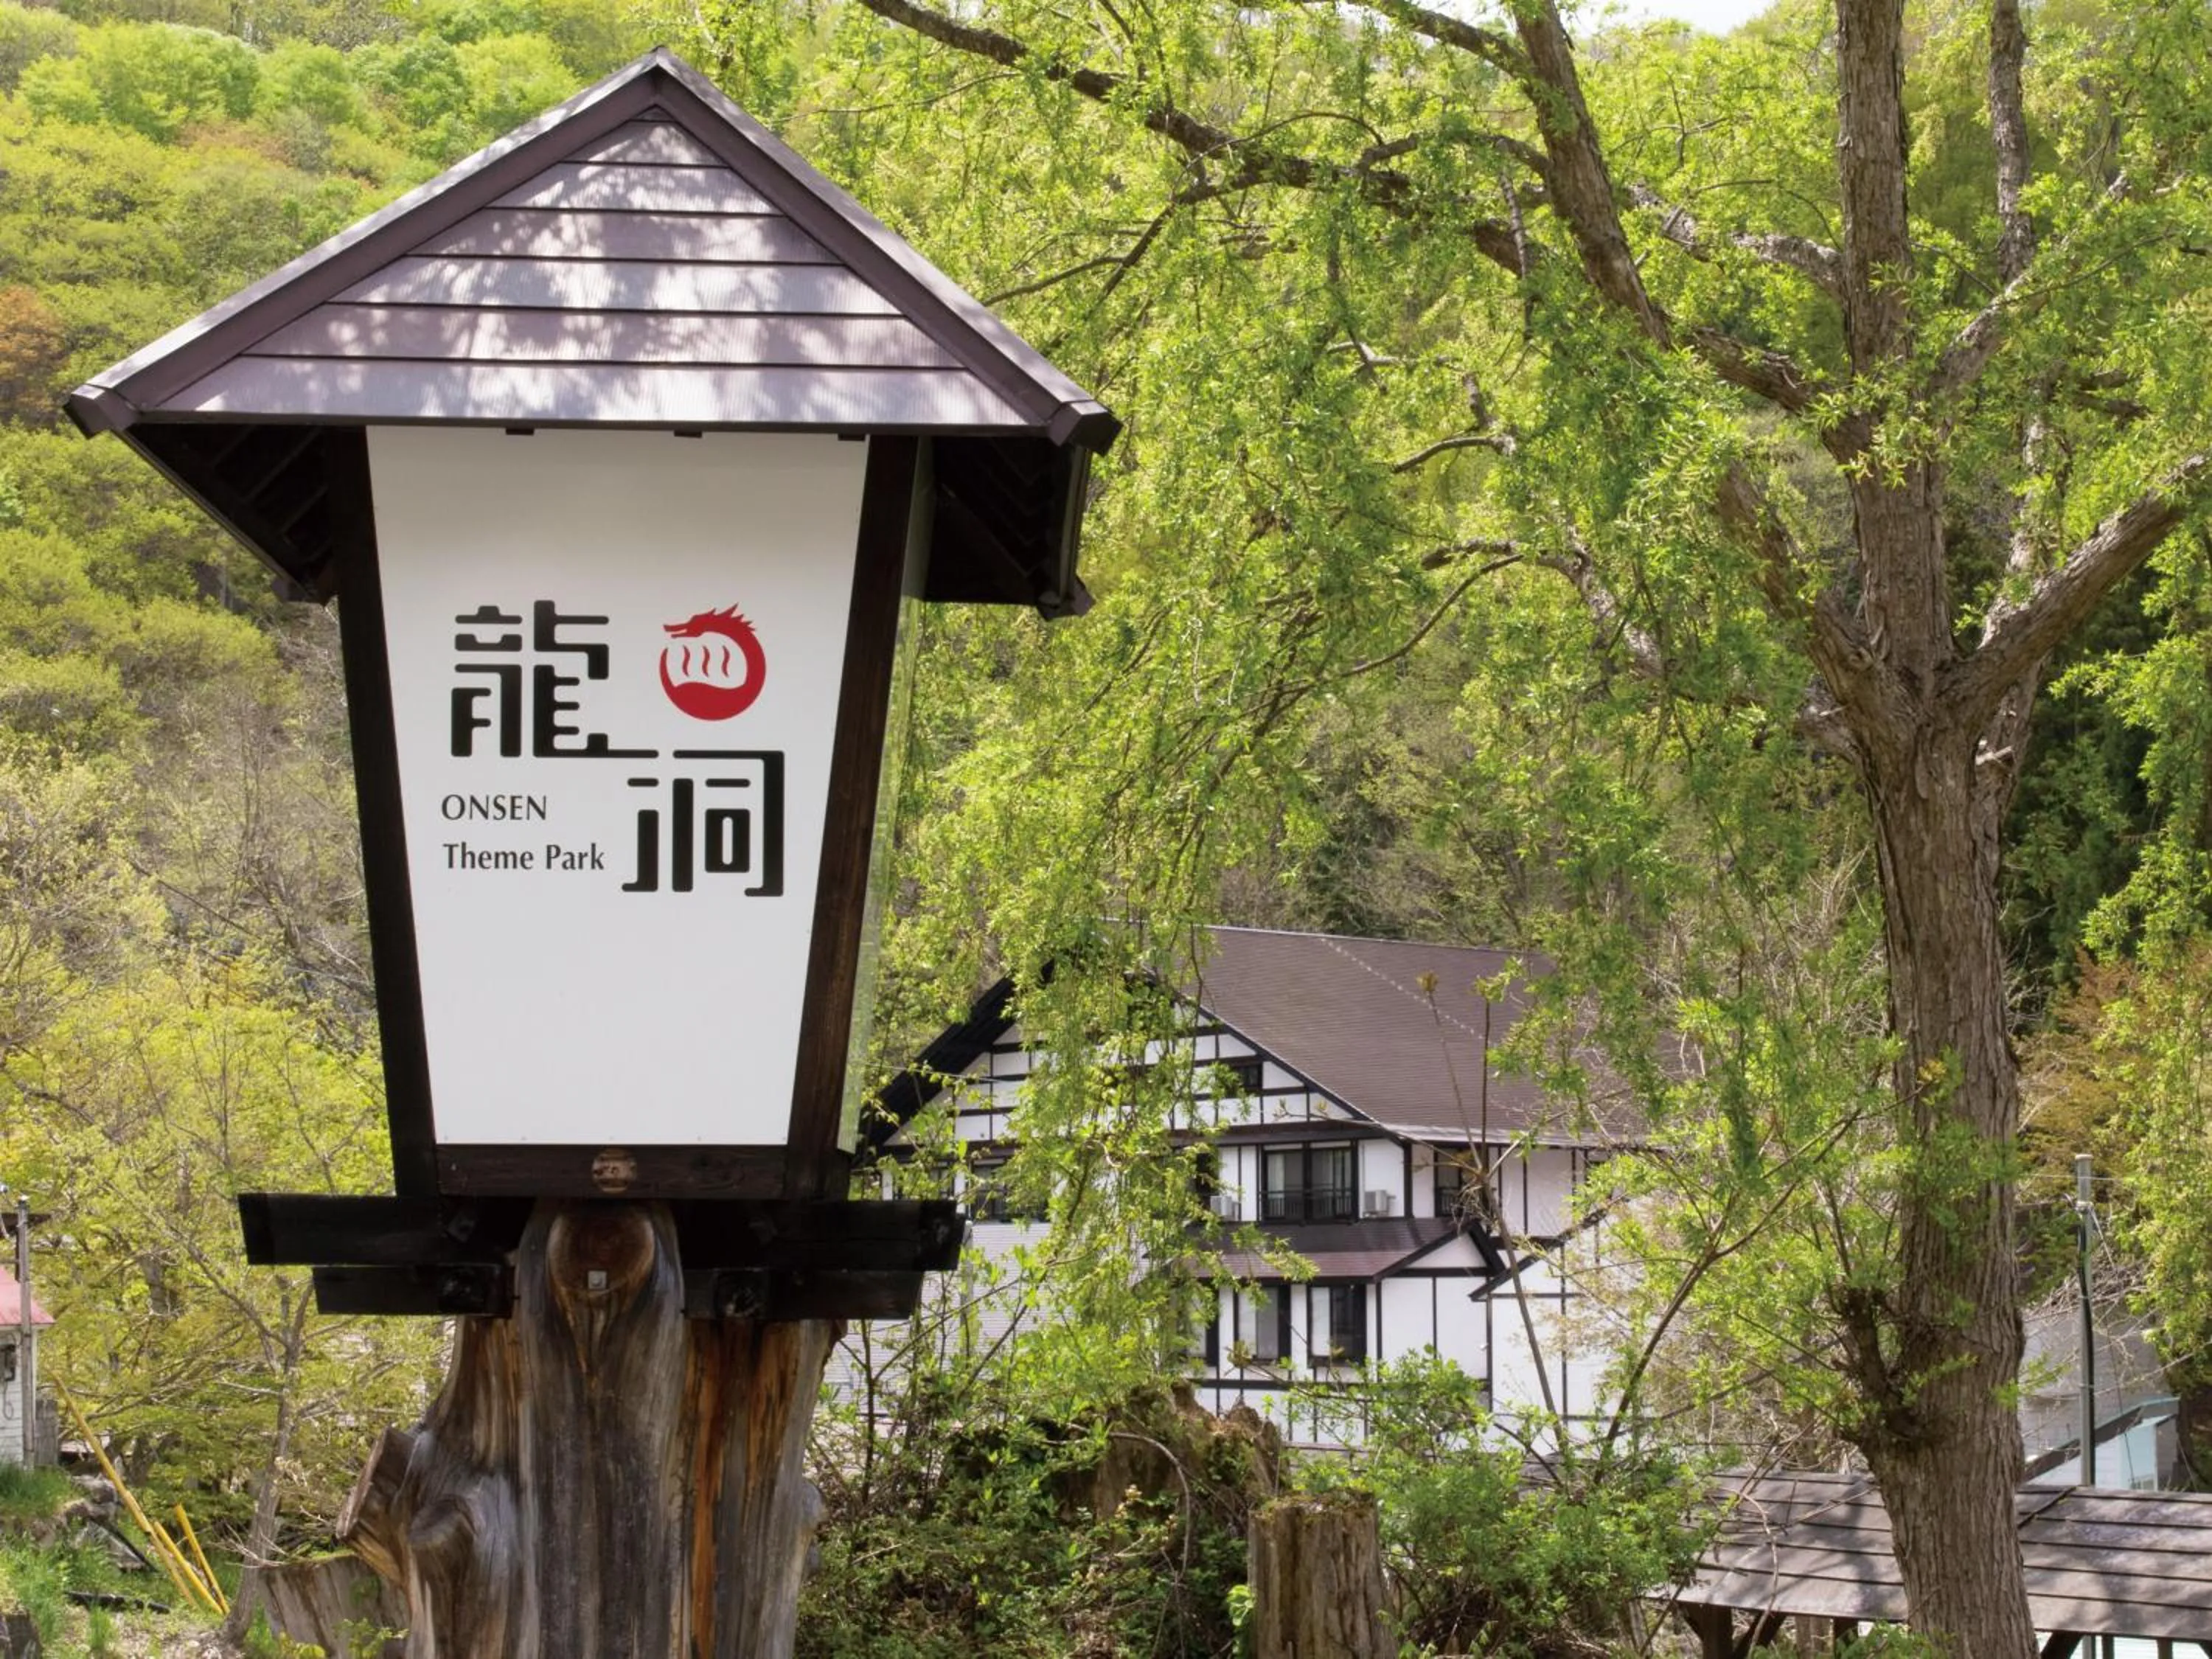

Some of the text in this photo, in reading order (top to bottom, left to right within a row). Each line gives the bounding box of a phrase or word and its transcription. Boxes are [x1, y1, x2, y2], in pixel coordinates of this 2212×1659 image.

[441, 794, 547, 821] ONSEN
[442, 841, 605, 871] Theme Park
